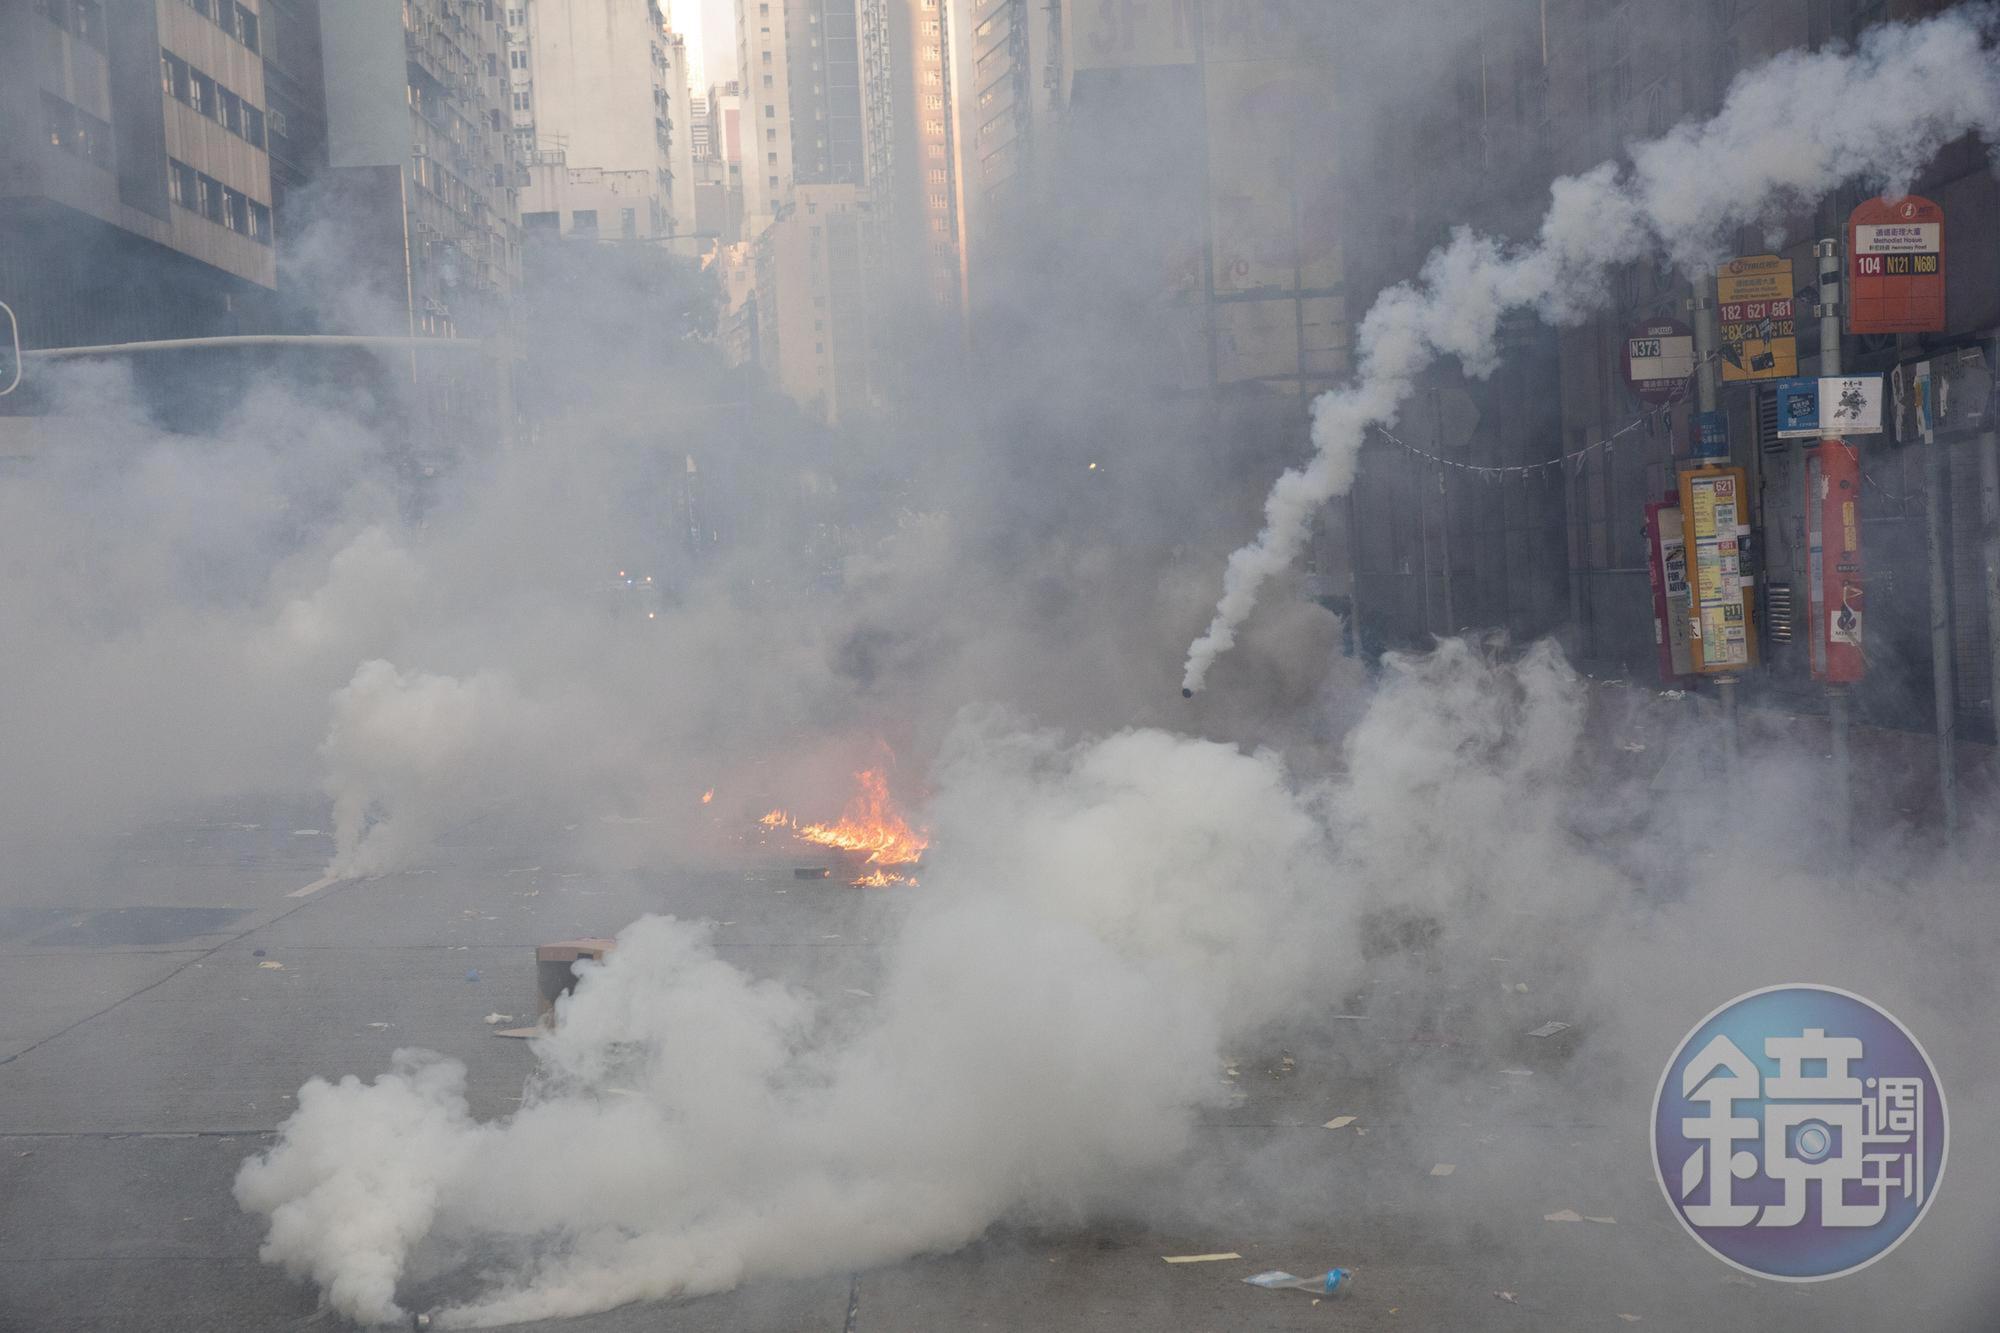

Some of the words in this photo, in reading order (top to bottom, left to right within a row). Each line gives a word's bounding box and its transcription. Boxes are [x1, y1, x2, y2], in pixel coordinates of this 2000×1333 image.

[1858, 257, 1881, 274] 104
[1887, 256, 1909, 274] N121
[1914, 255, 1937, 272] N680
[1721, 305, 1741, 320] 182
[1747, 303, 1766, 318] 621
[1772, 301, 1791, 317] 681
[1631, 340, 1660, 357] N373
[1716, 481, 1732, 491] 621
[1668, 572, 1680, 582] FOR
